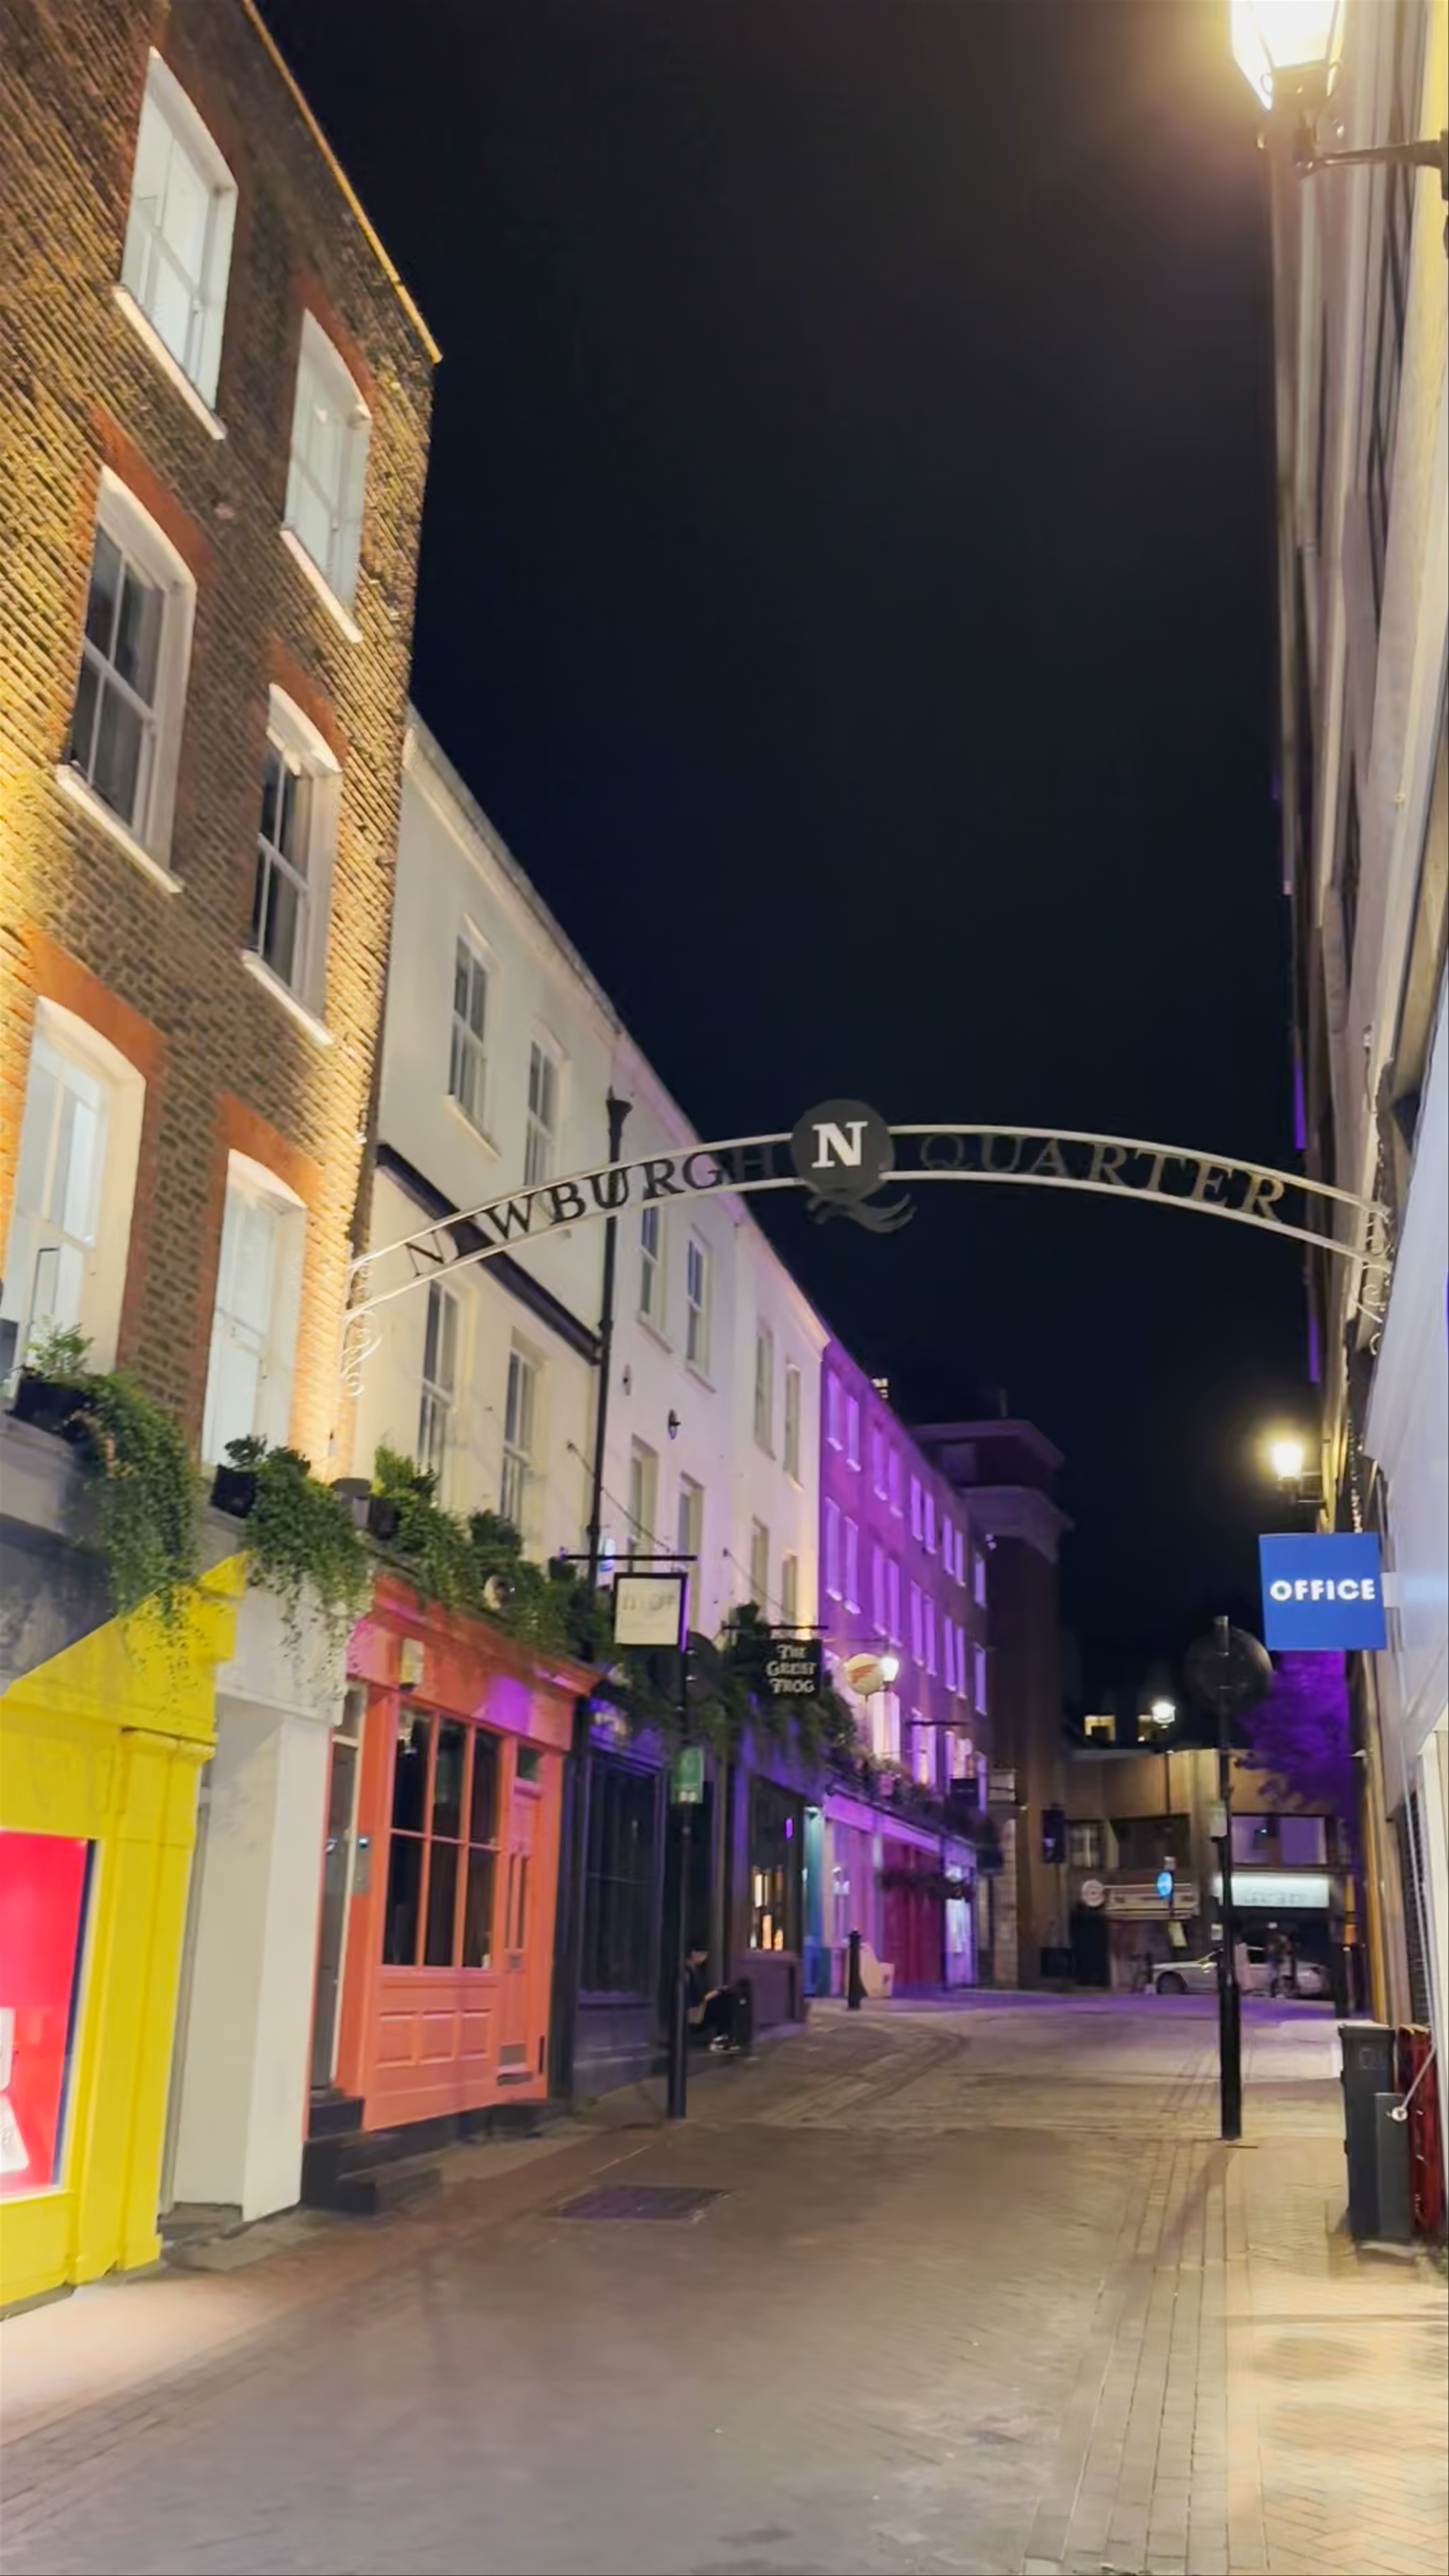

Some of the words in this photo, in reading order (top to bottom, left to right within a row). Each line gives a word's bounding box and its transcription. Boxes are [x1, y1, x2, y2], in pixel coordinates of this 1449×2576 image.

[811, 1121, 868, 1168] N
[920, 1133, 1284, 1223] QUARTER
[1270, 1579, 1375, 1601] OFFICE
